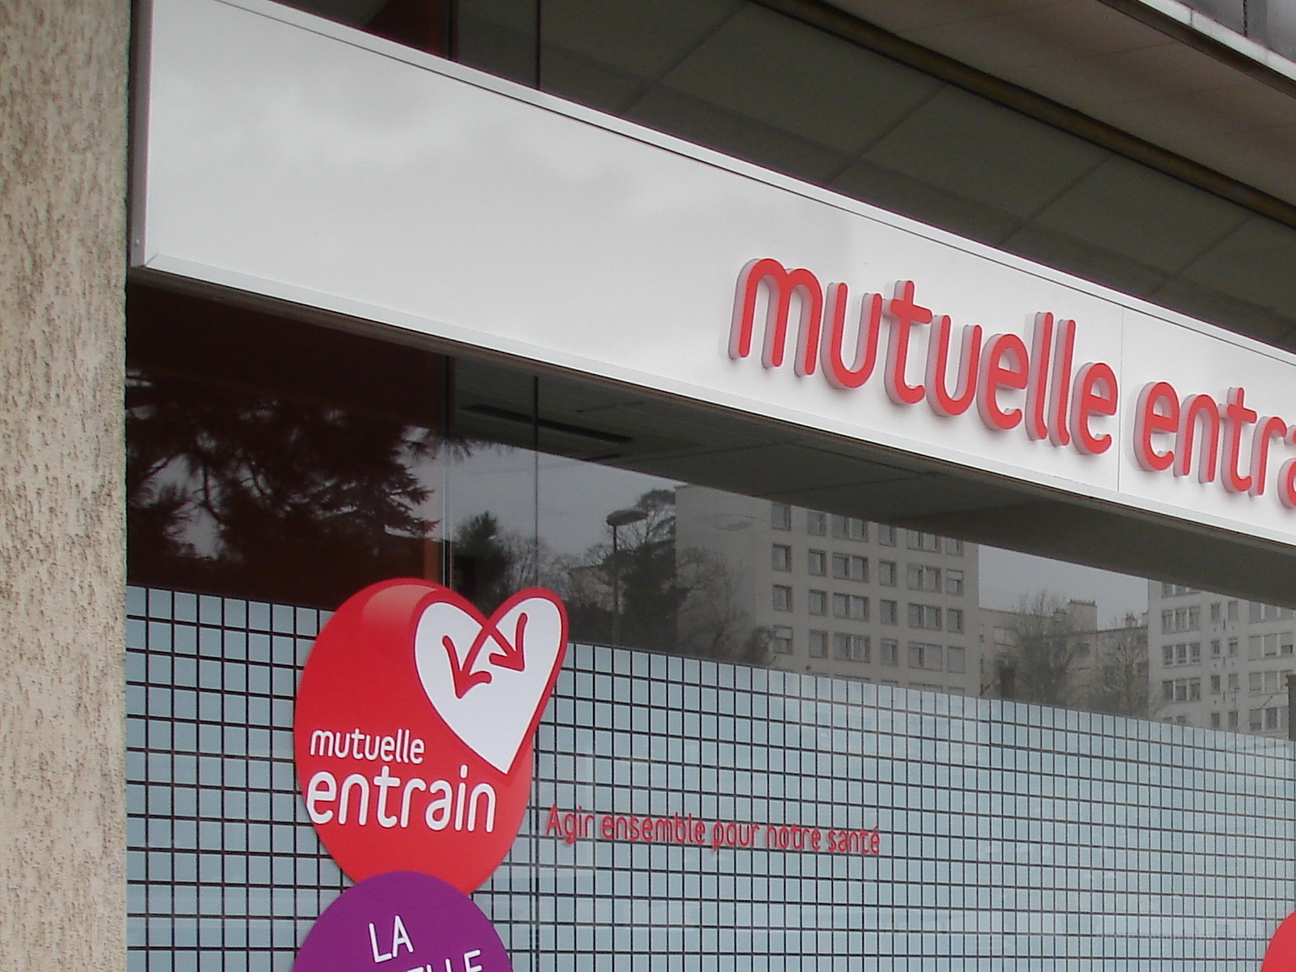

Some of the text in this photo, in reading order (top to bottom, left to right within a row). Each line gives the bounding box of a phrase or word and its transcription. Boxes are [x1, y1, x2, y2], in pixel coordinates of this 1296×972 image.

[728, 257, 1118, 455] mutuelle
[310, 728, 425, 764] mutuelle
[306, 764, 496, 833] entrain
[545, 804, 881, 855] Agir ensemble pour notre santé
[368, 915, 414, 963] LA
